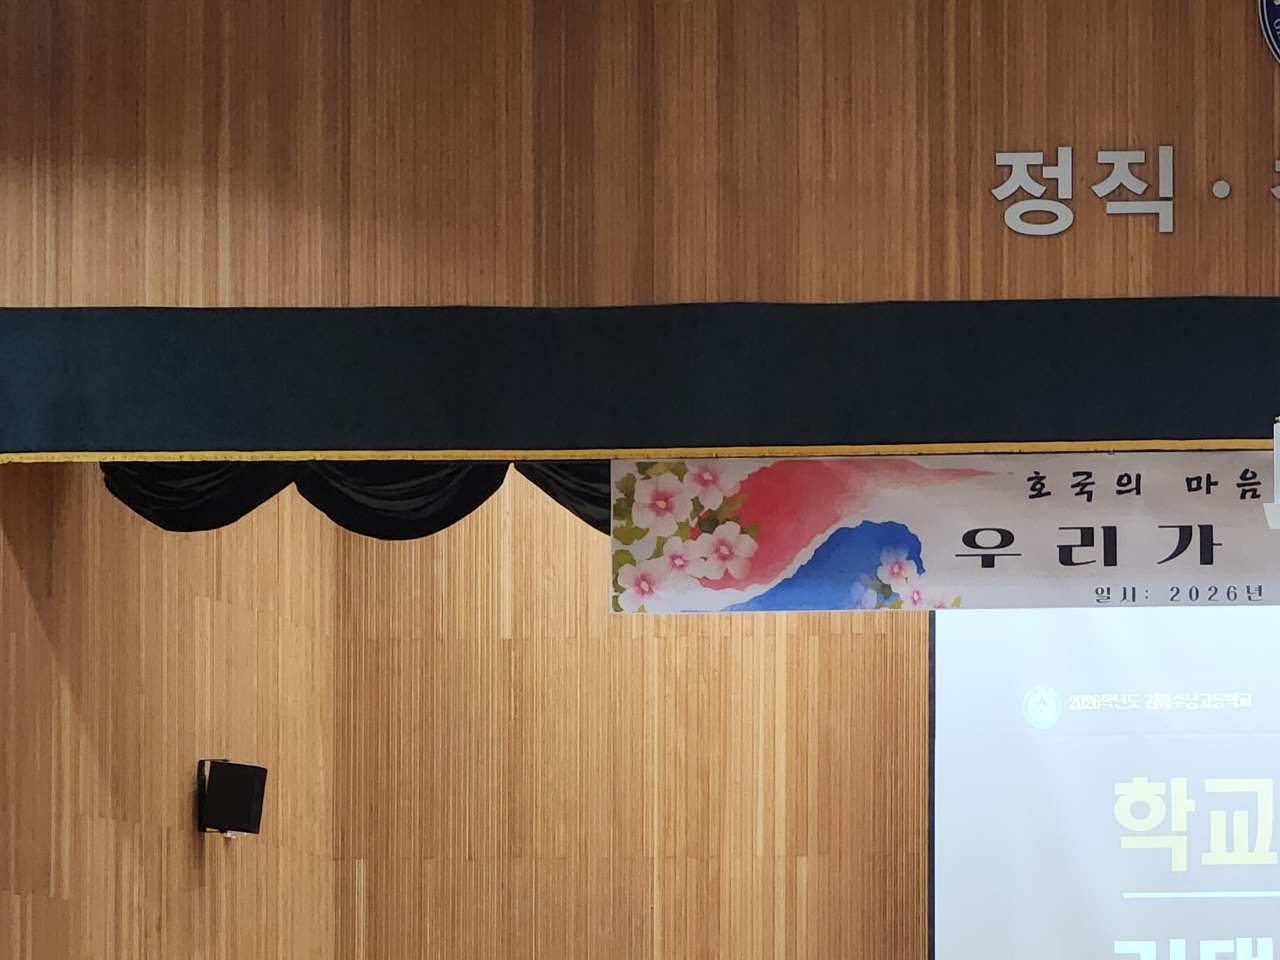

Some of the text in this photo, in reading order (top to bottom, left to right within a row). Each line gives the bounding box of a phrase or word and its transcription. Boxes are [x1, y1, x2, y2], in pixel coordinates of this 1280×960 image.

[991, 146, 1173, 236] 정직
[1027, 470, 1142, 502] 호국의
[954, 524, 1223, 567] 우리가
[1094, 585, 1149, 604] 일시:
[1169, 584, 1263, 603] 2026년
[1068, 692, 1252, 710] 2026학년도 김해수남고등학교
